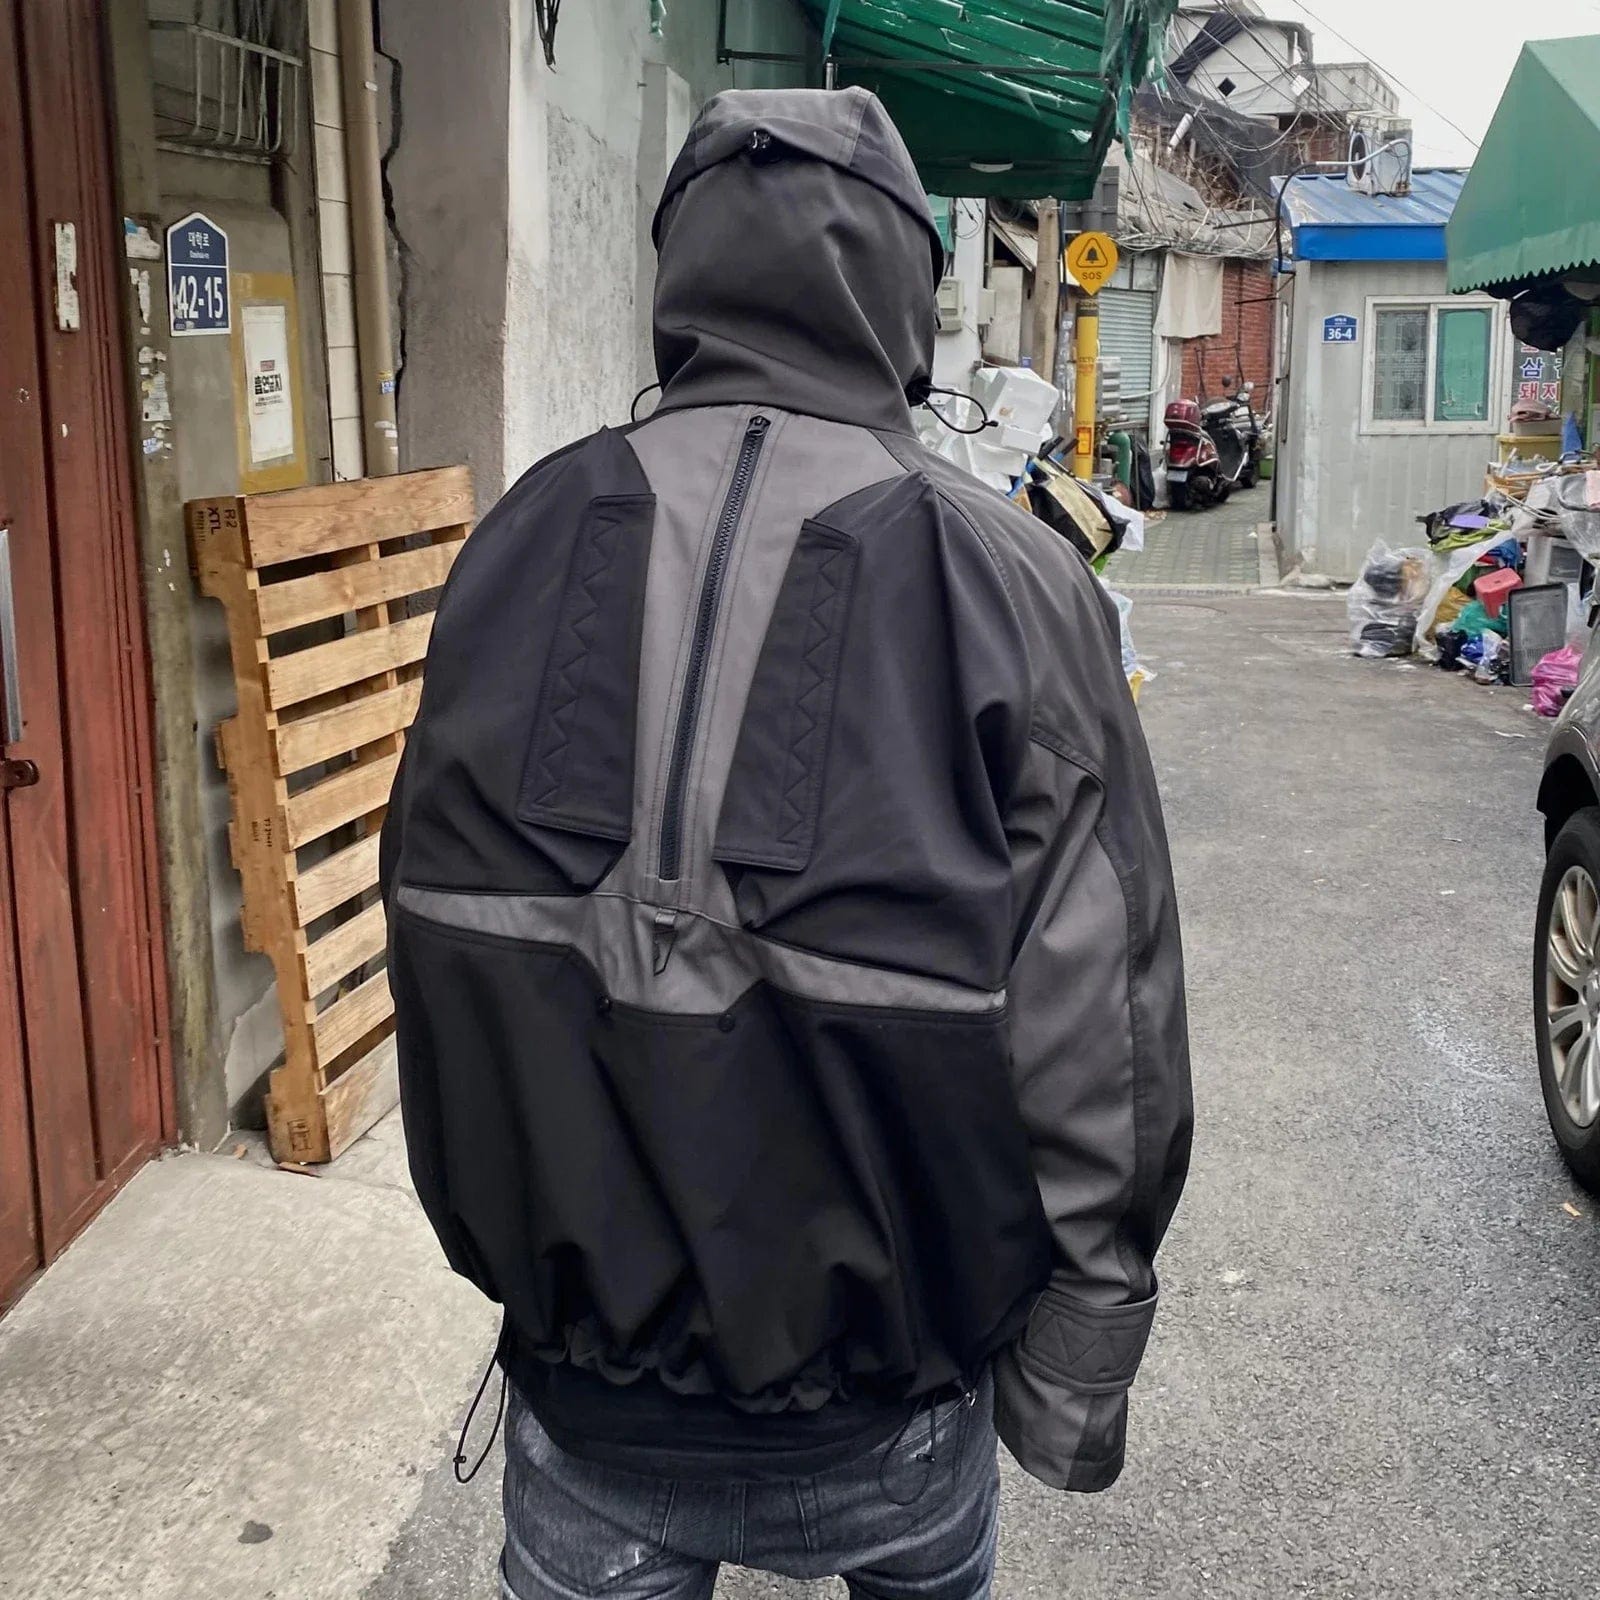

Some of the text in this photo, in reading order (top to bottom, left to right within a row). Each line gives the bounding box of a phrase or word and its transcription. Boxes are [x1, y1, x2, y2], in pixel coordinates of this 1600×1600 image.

[1082, 272, 1102, 280] SOS
[176, 275, 224, 319] 42-15
[1328, 328, 1352, 340] 36-4
[206, 506, 222, 535] XTL
[224, 508, 238, 528] R2
